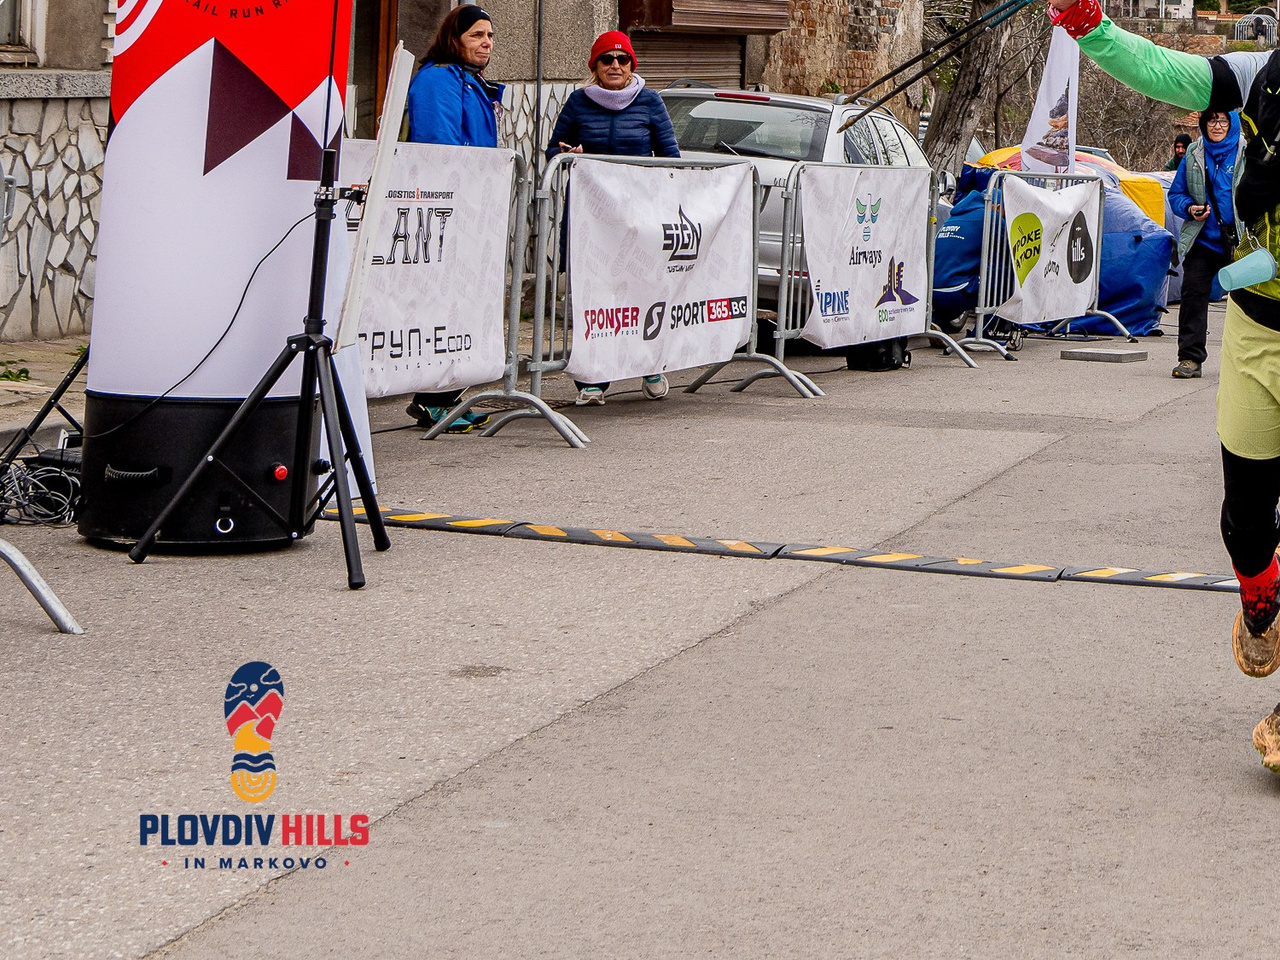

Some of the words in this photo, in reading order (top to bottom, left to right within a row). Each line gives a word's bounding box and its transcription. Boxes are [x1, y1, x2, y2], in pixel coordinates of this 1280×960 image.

[230, 6, 264, 19] RUN
[372, 208, 453, 265] ANT
[849, 246, 882, 268] Airways
[584, 307, 639, 340] SPONSER
